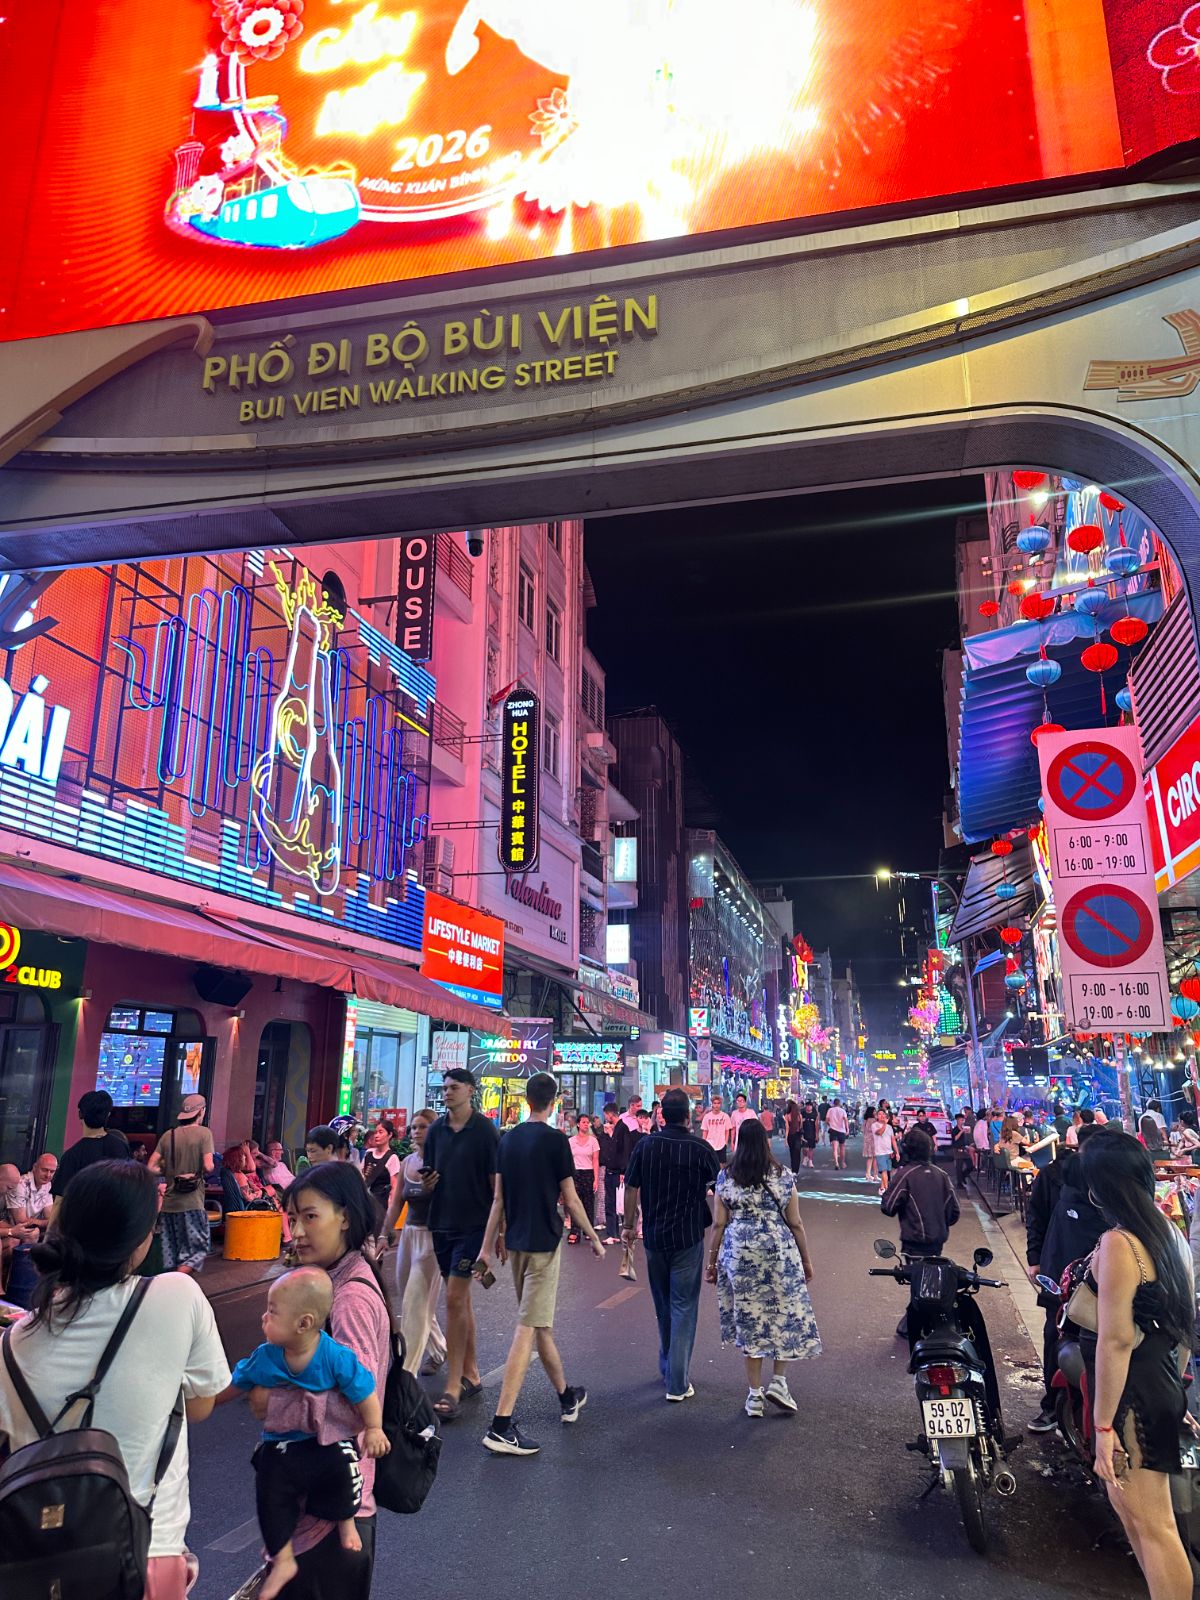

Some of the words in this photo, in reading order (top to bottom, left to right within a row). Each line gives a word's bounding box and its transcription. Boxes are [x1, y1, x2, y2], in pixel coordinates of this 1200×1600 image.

[391, 125, 492, 172] 2026
[202, 334, 296, 393] PHỐ
[307, 338, 351, 376] ĐI
[366, 320, 428, 373] BỘ
[444, 309, 521, 355] BÙI
[538, 294, 657, 348] VIỆN
[239, 395, 285, 424] BUI
[293, 384, 360, 416] VIEN
[369, 366, 506, 404] WALKING
[514, 351, 619, 387] STREET
[507, 700, 534, 709] ZHONG
[512, 709, 528, 717] HUA
[511, 721, 528, 794] HOTEL
[1068, 835, 1092, 848] 6:00
[1104, 833, 1128, 847] 9:00
[1065, 857, 1093, 871] 16:00
[1106, 855, 1135, 869] 19:00
[428, 916, 470, 947] LIFESTYLE
[471, 931, 500, 956] MARKET
[1081, 983, 1105, 996] 9:00
[1119, 982, 1149, 996] 16:00
[1084, 1005, 1113, 1019] 19:00
[1126, 1005, 1150, 1018] 6:00
[480, 1038, 521, 1049] DRAGON
[523, 1039, 539, 1049] FLY
[602, 1043, 623, 1052] FLY
[489, 1052, 527, 1063] TATTOO
[561, 1051, 617, 1063] TATTOO
[931, 1402, 965, 1418] 59-D2
[929, 1418, 970, 1435] 946.87
